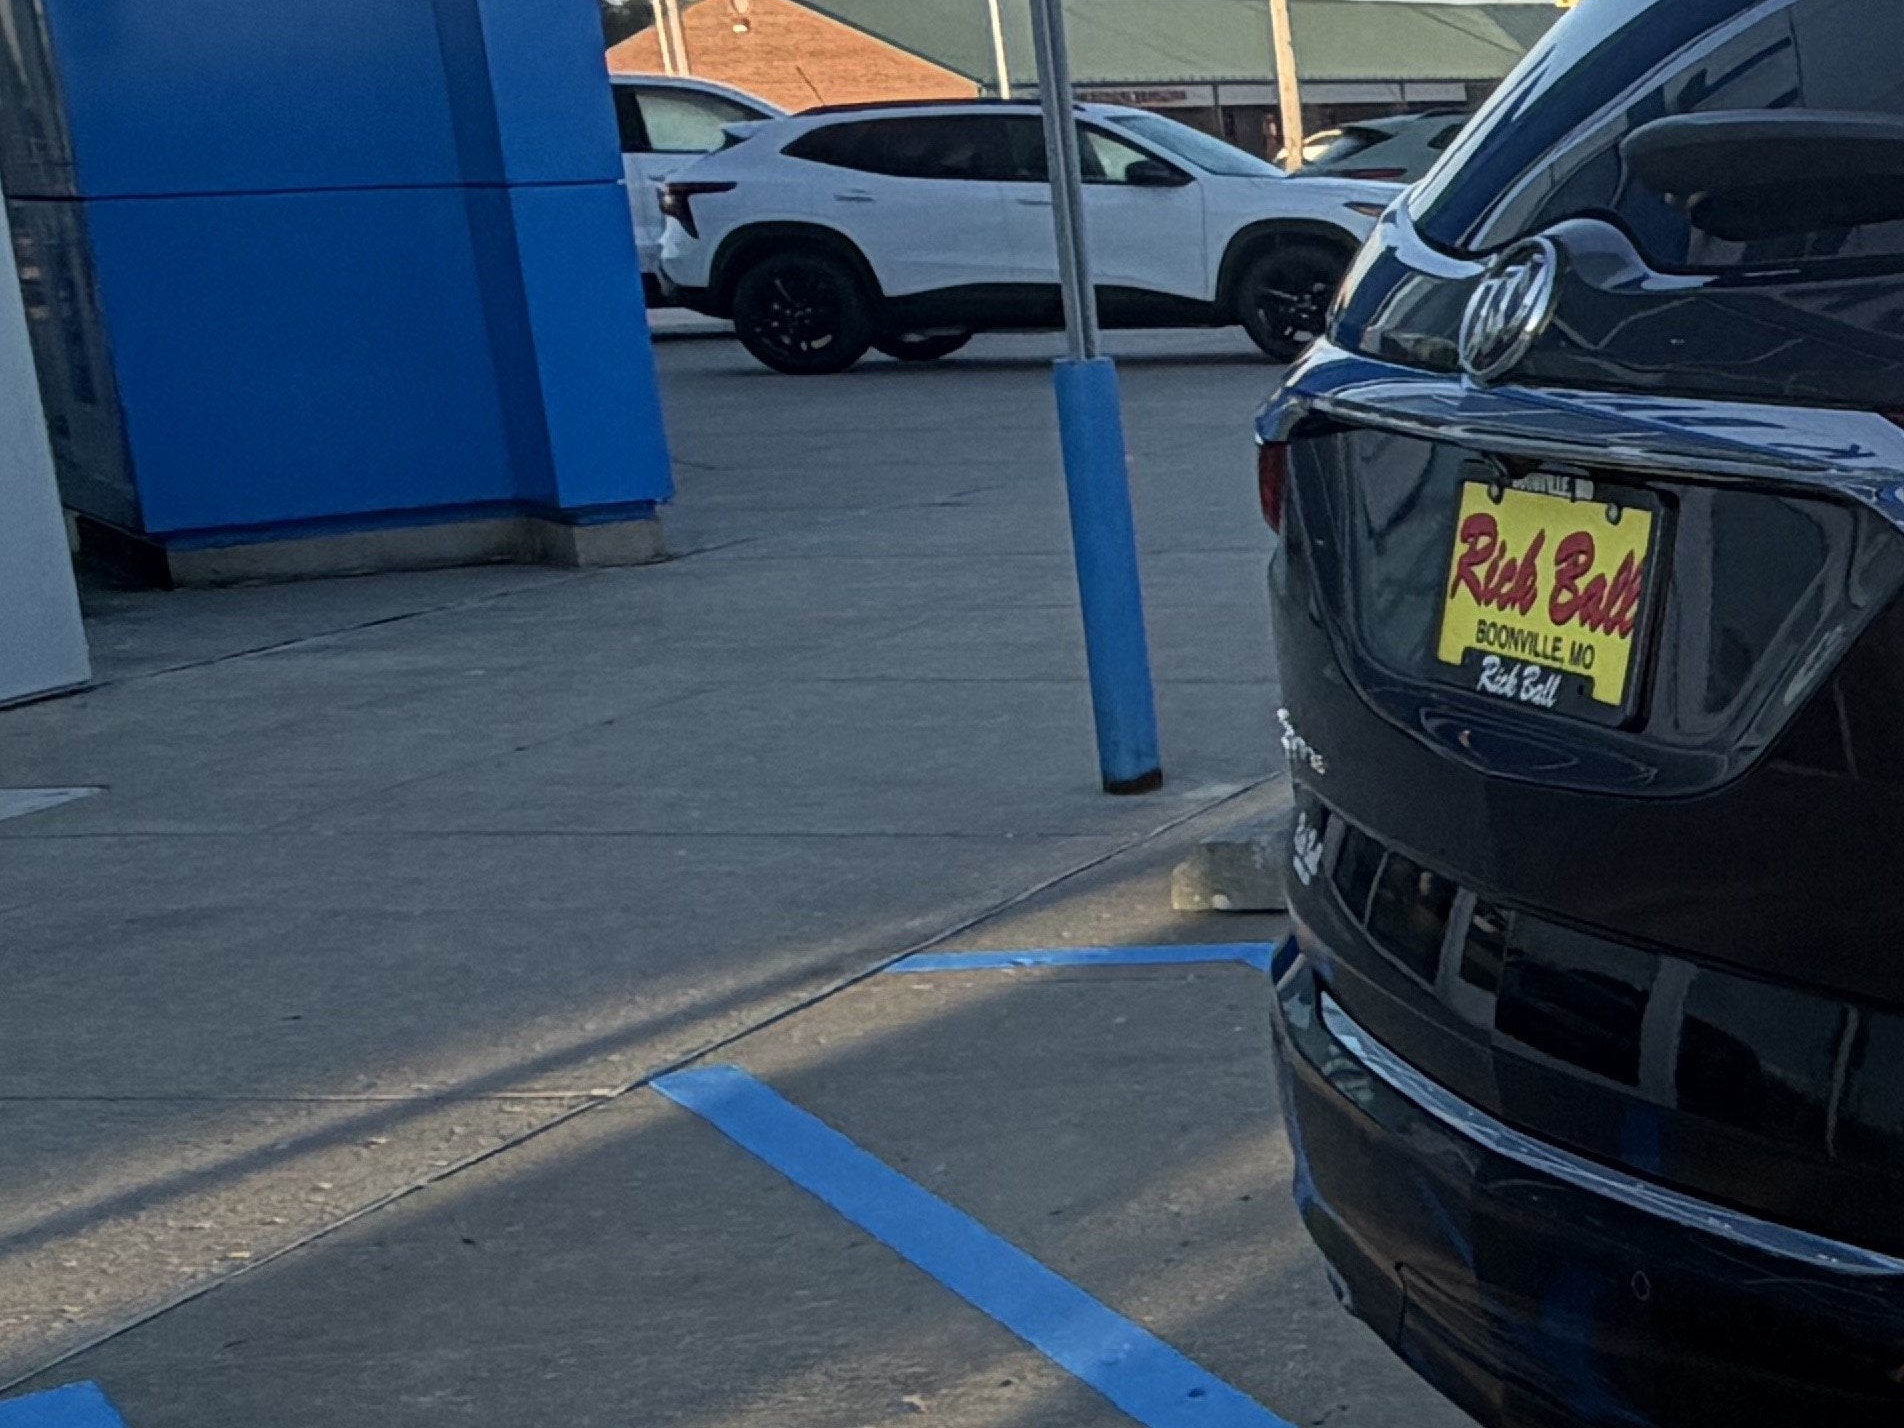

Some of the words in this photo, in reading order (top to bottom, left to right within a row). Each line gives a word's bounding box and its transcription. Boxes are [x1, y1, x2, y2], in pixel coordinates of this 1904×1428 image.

[1450, 512, 1546, 616] Rick
[1549, 531, 1642, 639] Ball
[1476, 619, 1565, 664] BOONVILLE,
[1569, 640, 1596, 670] MO
[1476, 655, 1522, 699] Rick
[1519, 665, 1563, 708] Ball
